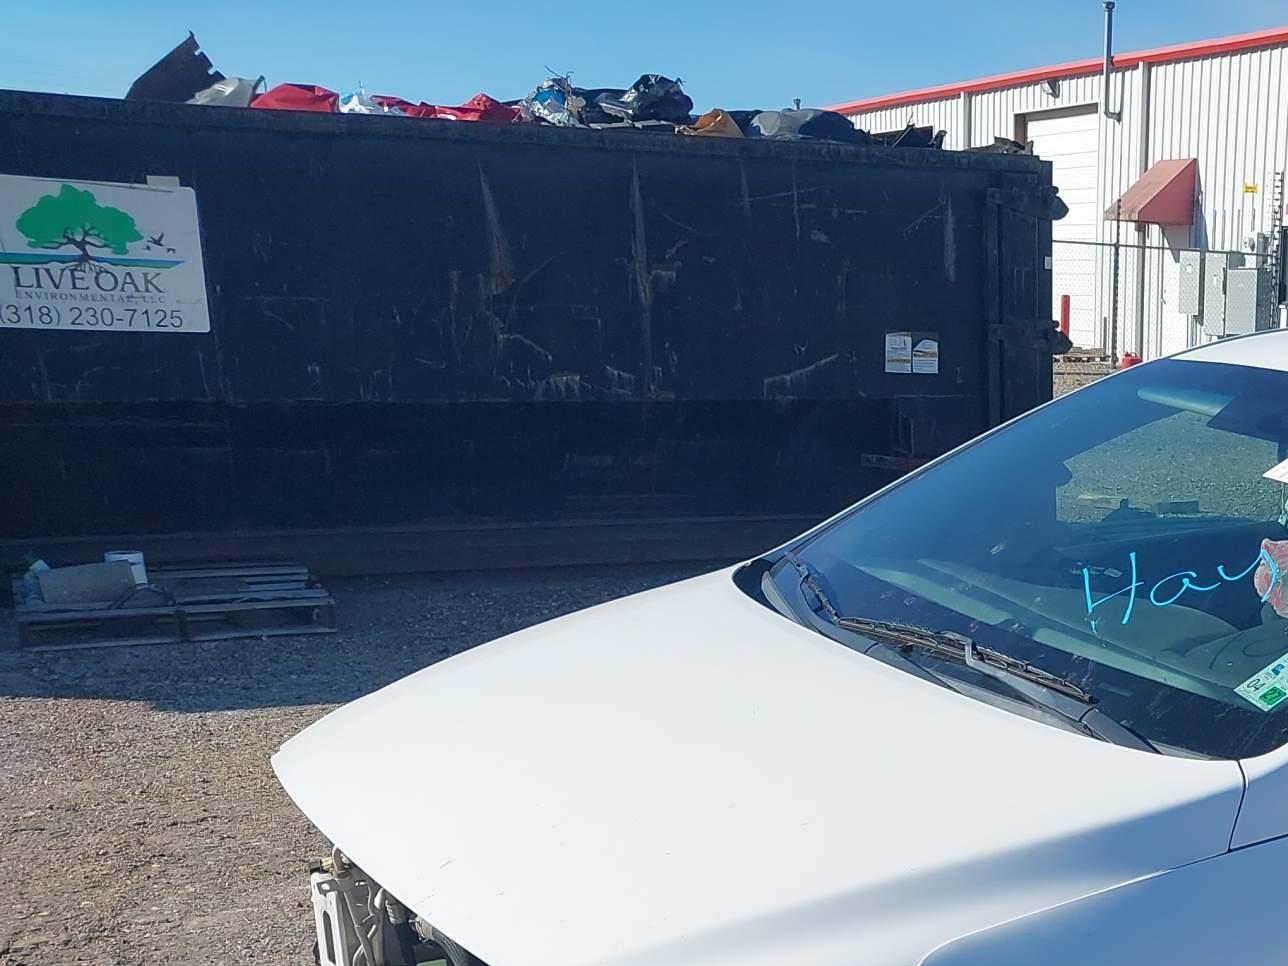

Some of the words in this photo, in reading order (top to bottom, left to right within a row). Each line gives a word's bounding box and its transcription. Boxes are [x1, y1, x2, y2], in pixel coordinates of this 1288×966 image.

[11, 266, 89, 291] LIVE
[94, 269, 166, 294] OAK
[0, 304, 61, 326] (318)
[69, 306, 183, 328] 230-7125
[1246, 678, 1267, 692] 04
[1262, 687, 1282, 702] 27
